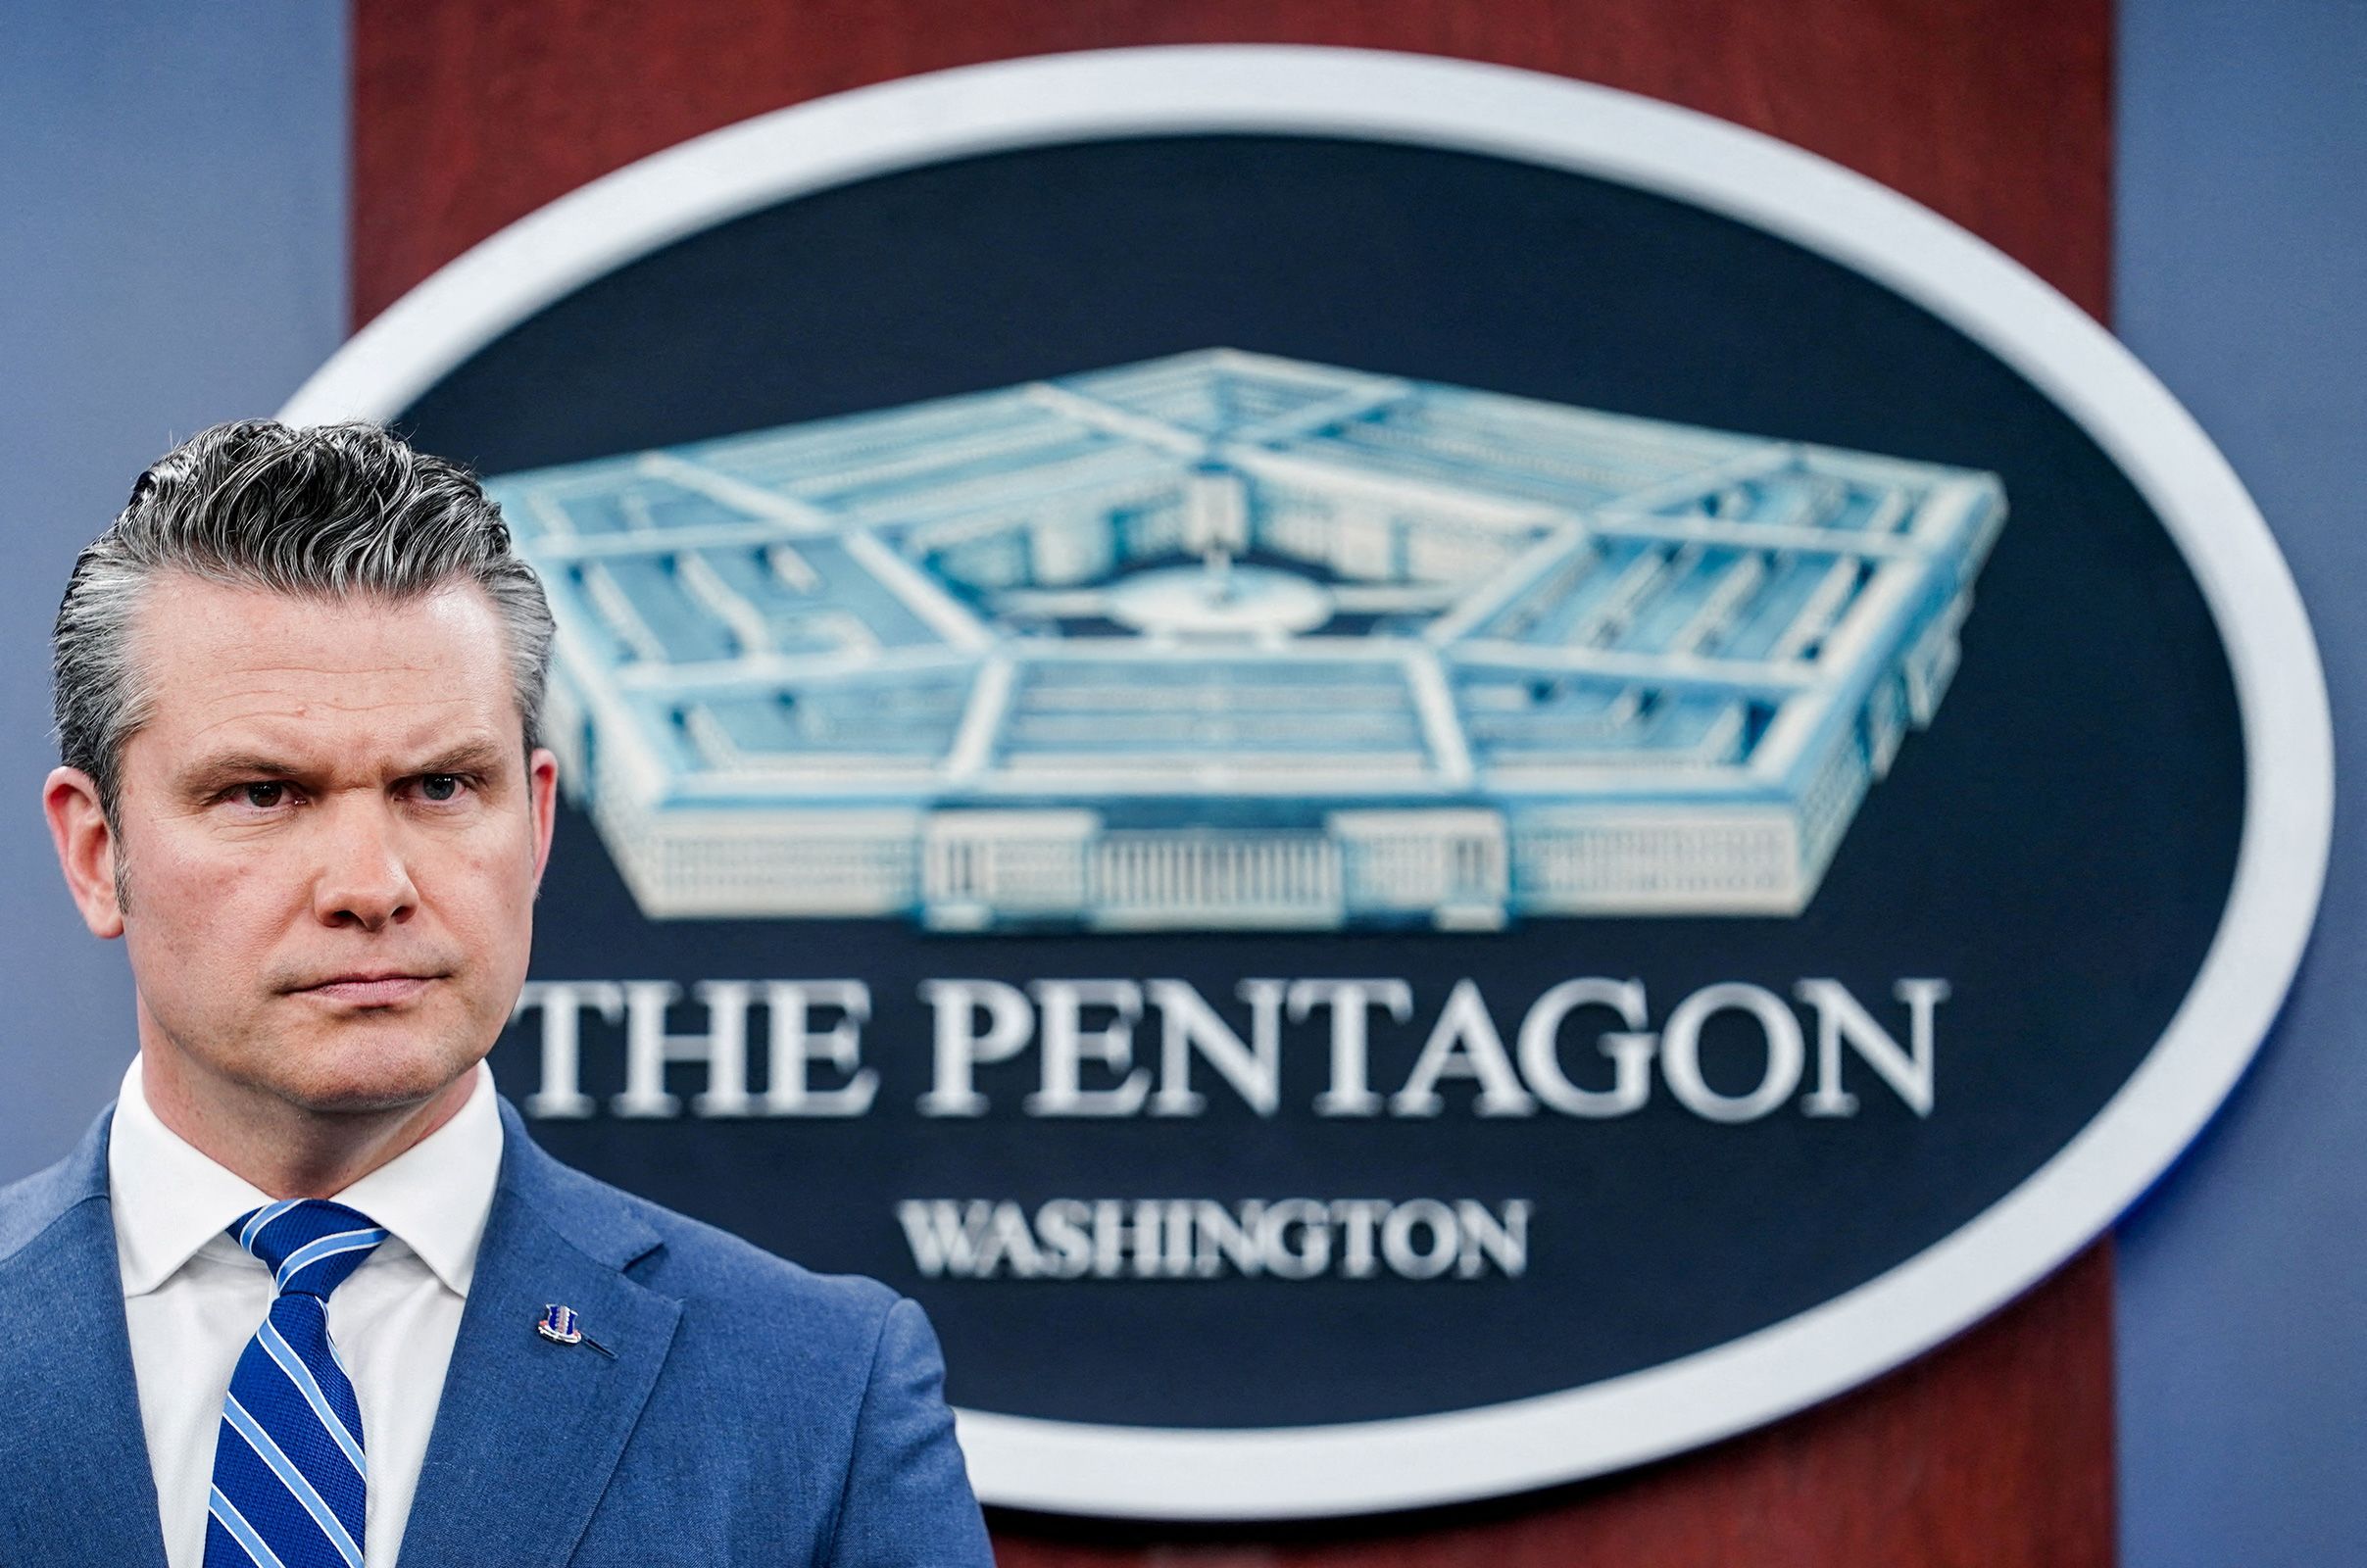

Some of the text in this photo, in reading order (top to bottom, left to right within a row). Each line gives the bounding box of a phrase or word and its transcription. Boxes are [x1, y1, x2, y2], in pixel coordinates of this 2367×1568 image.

[511, 978, 1951, 1123] THE PENTAGON
[897, 1198, 1531, 1279] WASHINGTON
